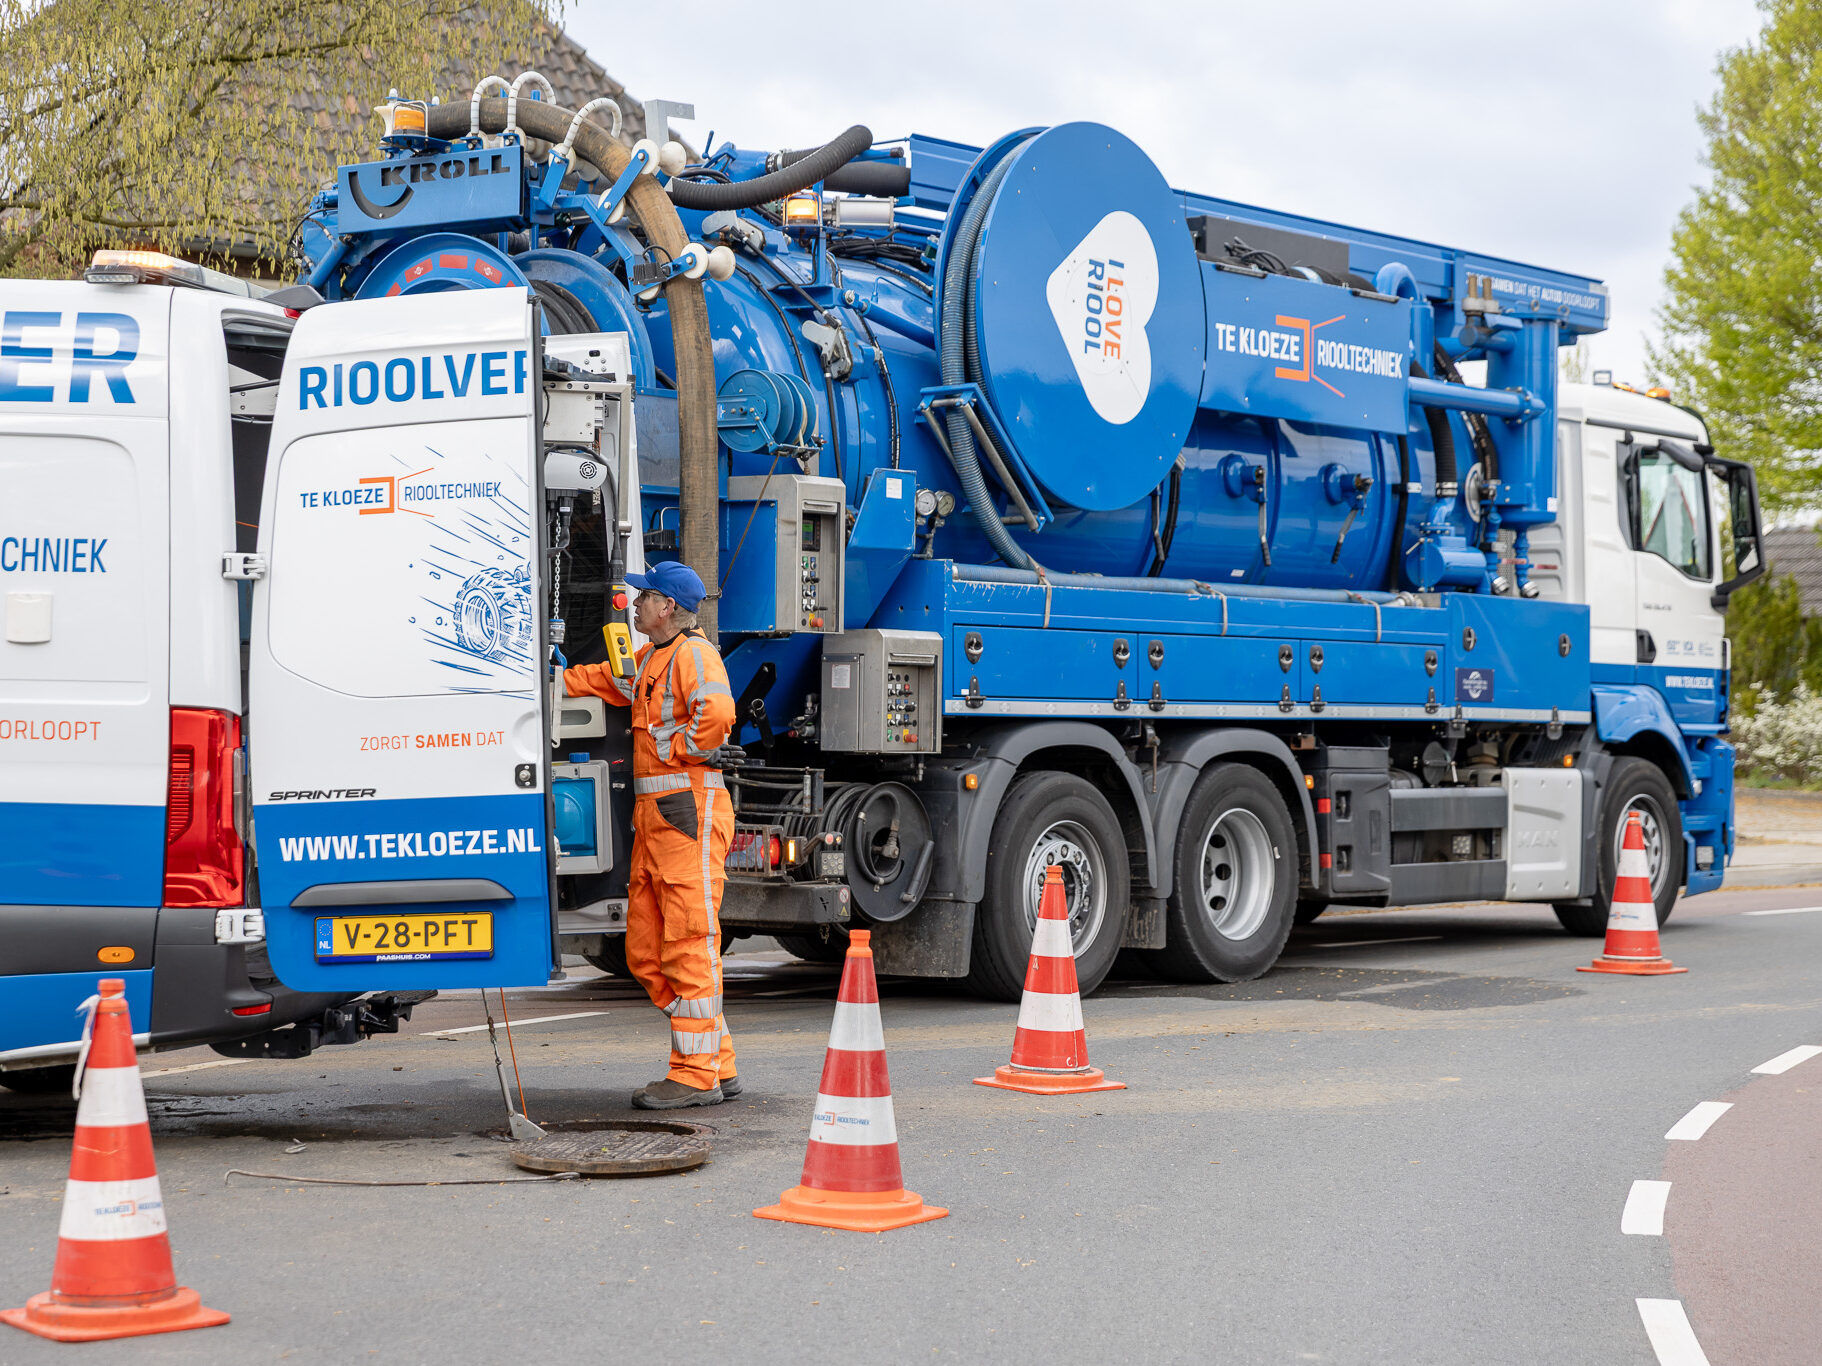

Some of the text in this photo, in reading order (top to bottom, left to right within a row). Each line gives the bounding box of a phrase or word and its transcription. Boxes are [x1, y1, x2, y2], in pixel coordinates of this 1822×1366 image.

[381, 154, 511, 187] KROLL
[1084, 259, 1105, 354] RIOOL
[1104, 259, 1124, 360] I LOVE
[0, 311, 140, 403] ER
[1215, 323, 1404, 379] TE KLOEZE RIOOLTECHNIEK
[300, 482, 501, 508] TE KLOEZE RIOOLTECHNIEK
[2, 537, 108, 573] CHNIEK
[0, 720, 102, 740] ORLOOPT
[360, 731, 505, 751] ZORGT SAMEN DAT
[268, 788, 377, 801] SPRINTER
[279, 828, 541, 862] WWW.TEKLOEZE.NL
[319, 940, 332, 950] NL
[344, 920, 478, 949] V-28-PFT
[376, 953, 431, 962] PAASHUIS.COM
